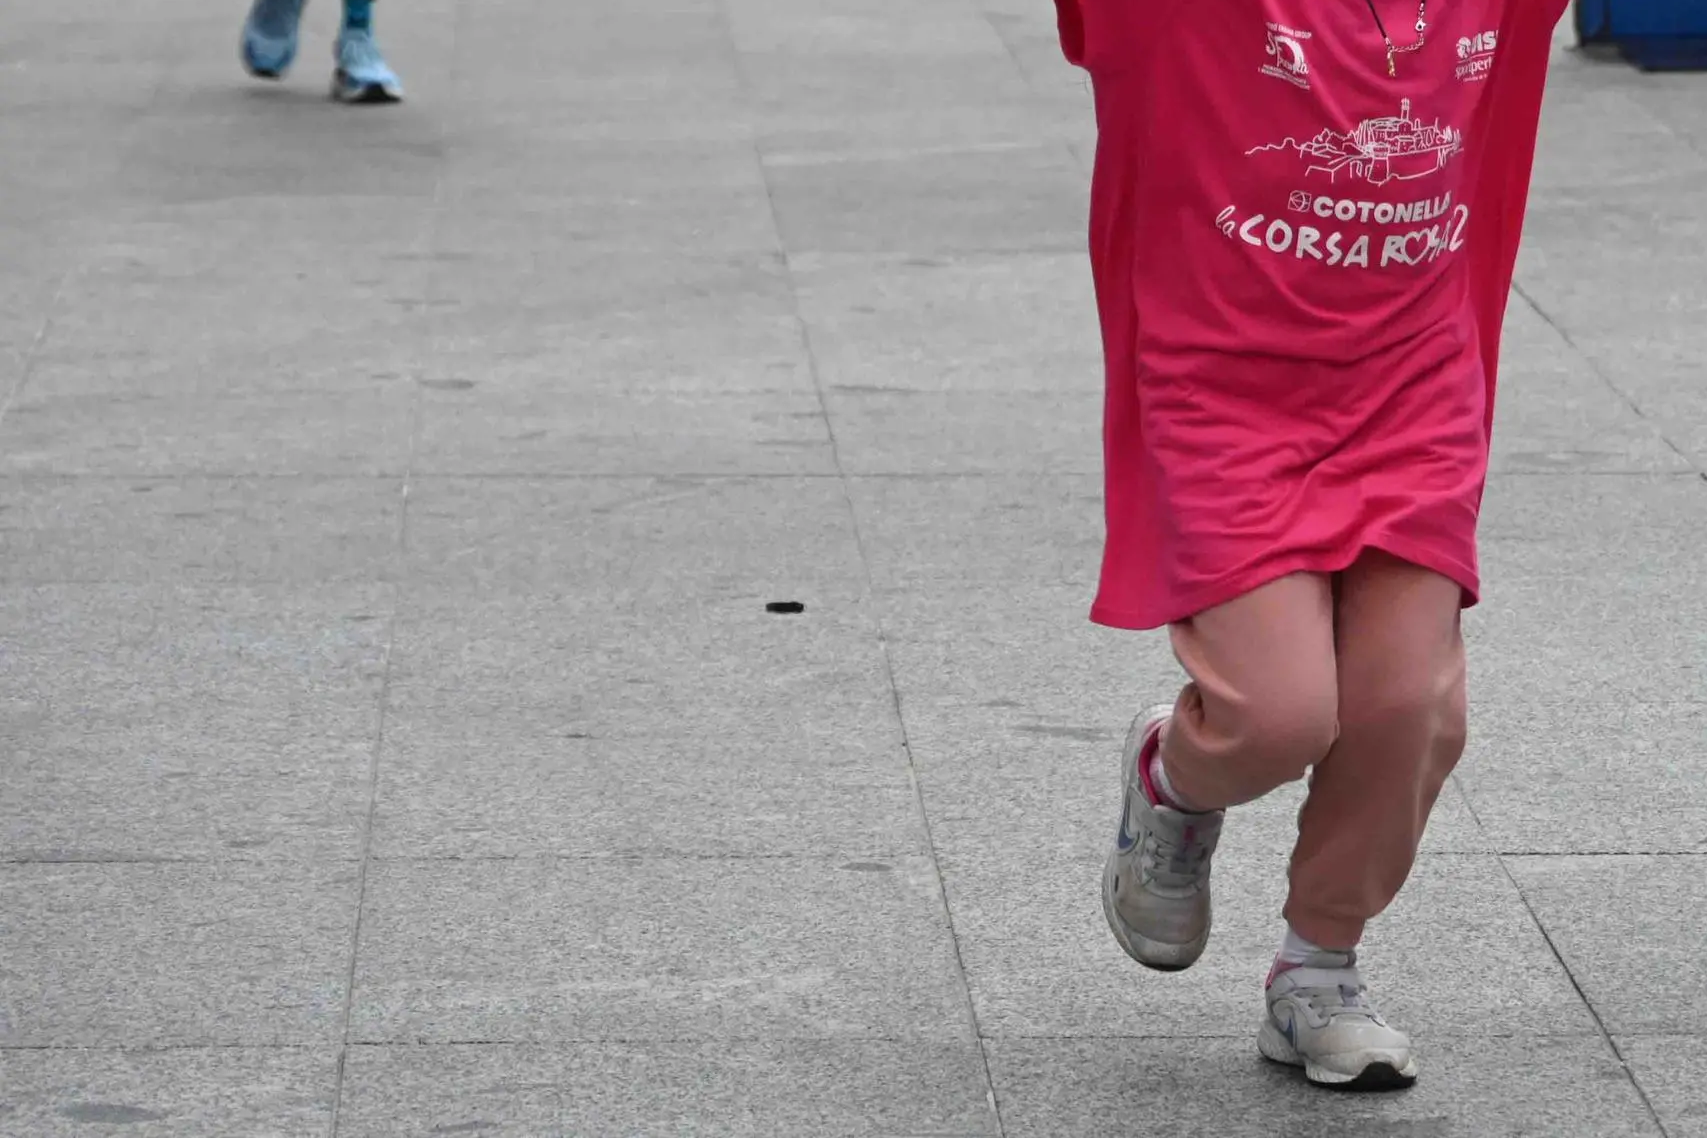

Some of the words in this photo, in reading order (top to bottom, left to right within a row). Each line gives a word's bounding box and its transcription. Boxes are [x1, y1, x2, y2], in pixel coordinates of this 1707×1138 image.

[1312, 190, 1452, 224] COTONELLA
[1215, 205, 1236, 238] la
[1238, 213, 1370, 268] CORSA
